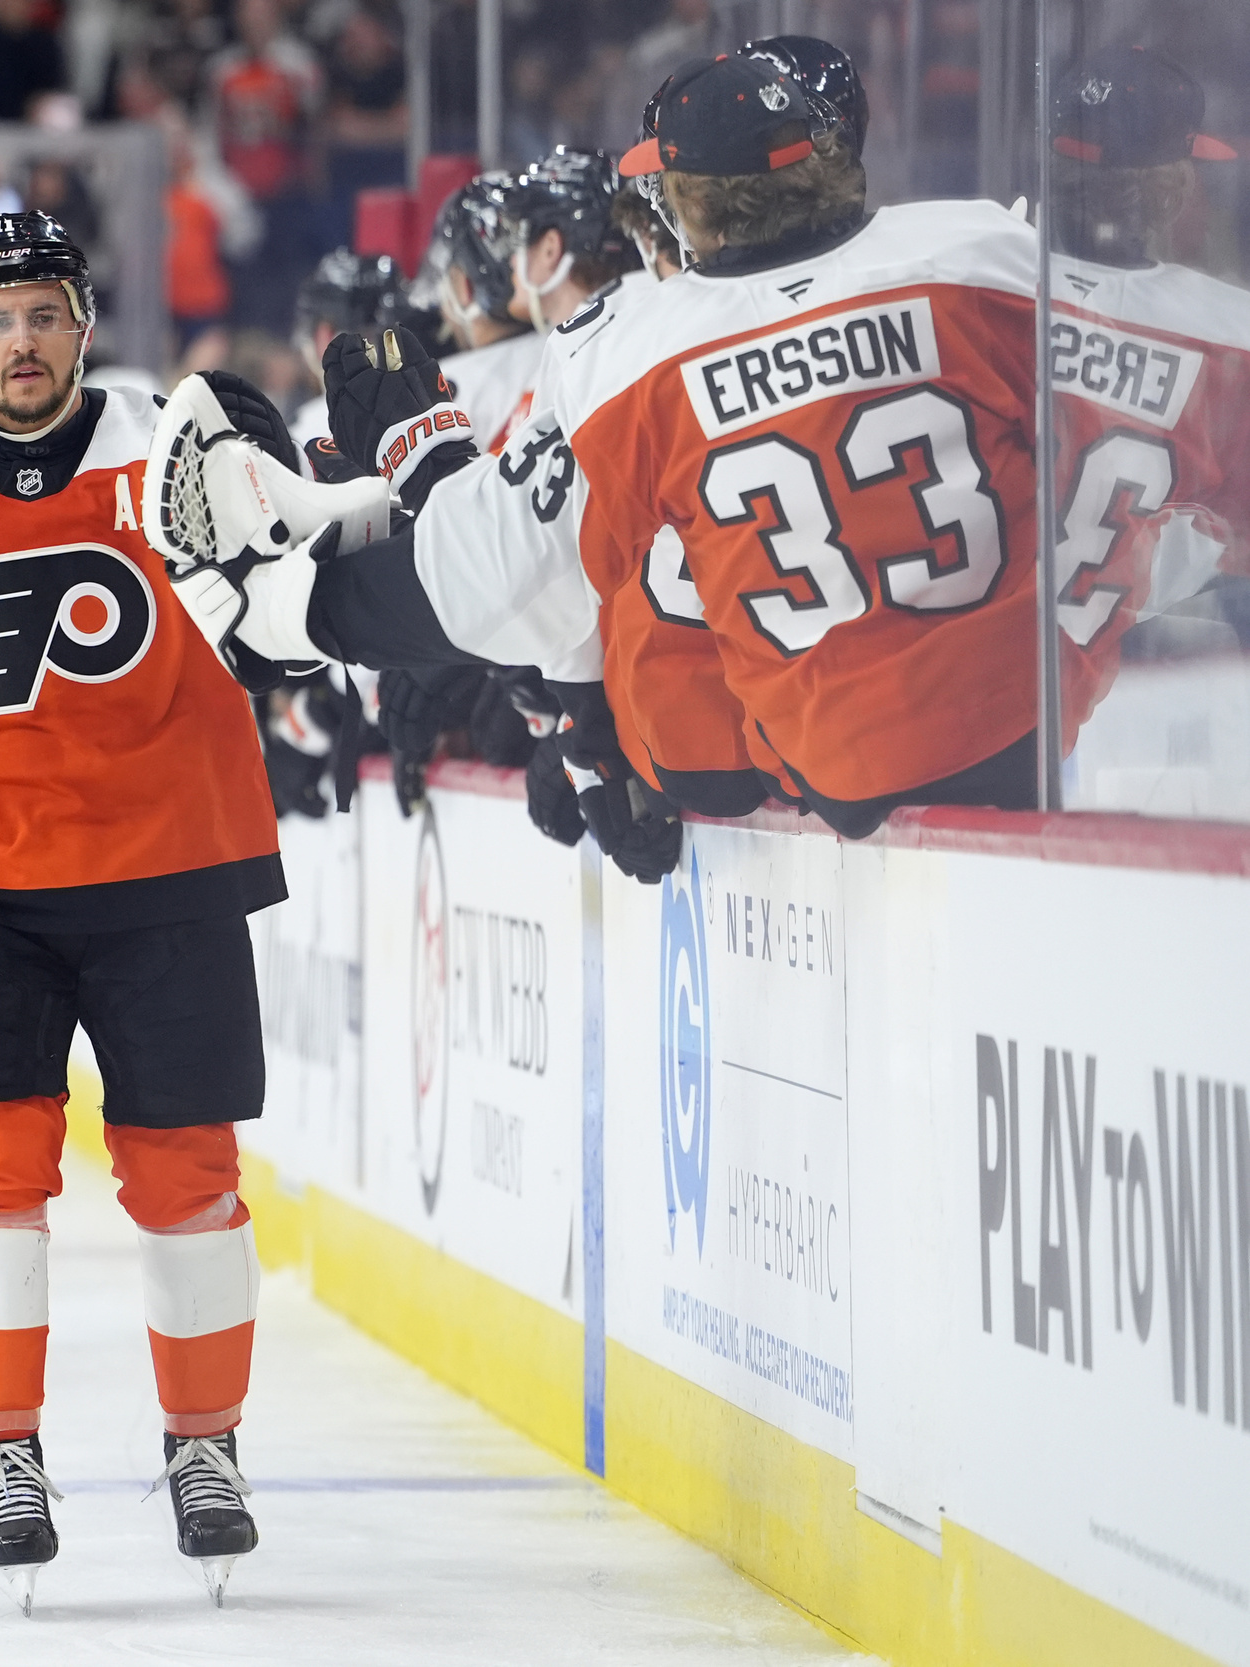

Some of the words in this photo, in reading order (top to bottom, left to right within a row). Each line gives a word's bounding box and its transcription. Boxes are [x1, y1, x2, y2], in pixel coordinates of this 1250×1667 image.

[701, 311, 922, 425] ERSSON
[113, 473, 139, 531] A
[499, 426, 576, 524] 33
[698, 382, 1008, 659] 33
[486, 911, 548, 1078] WEBB
[727, 1164, 839, 1303] HYPERBARIC
[975, 1032, 1097, 1372] PLAY
[1103, 1126, 1152, 1345] TO
[745, 1322, 789, 1391] ACCELERATE
[789, 1343, 810, 1403] YOUR
